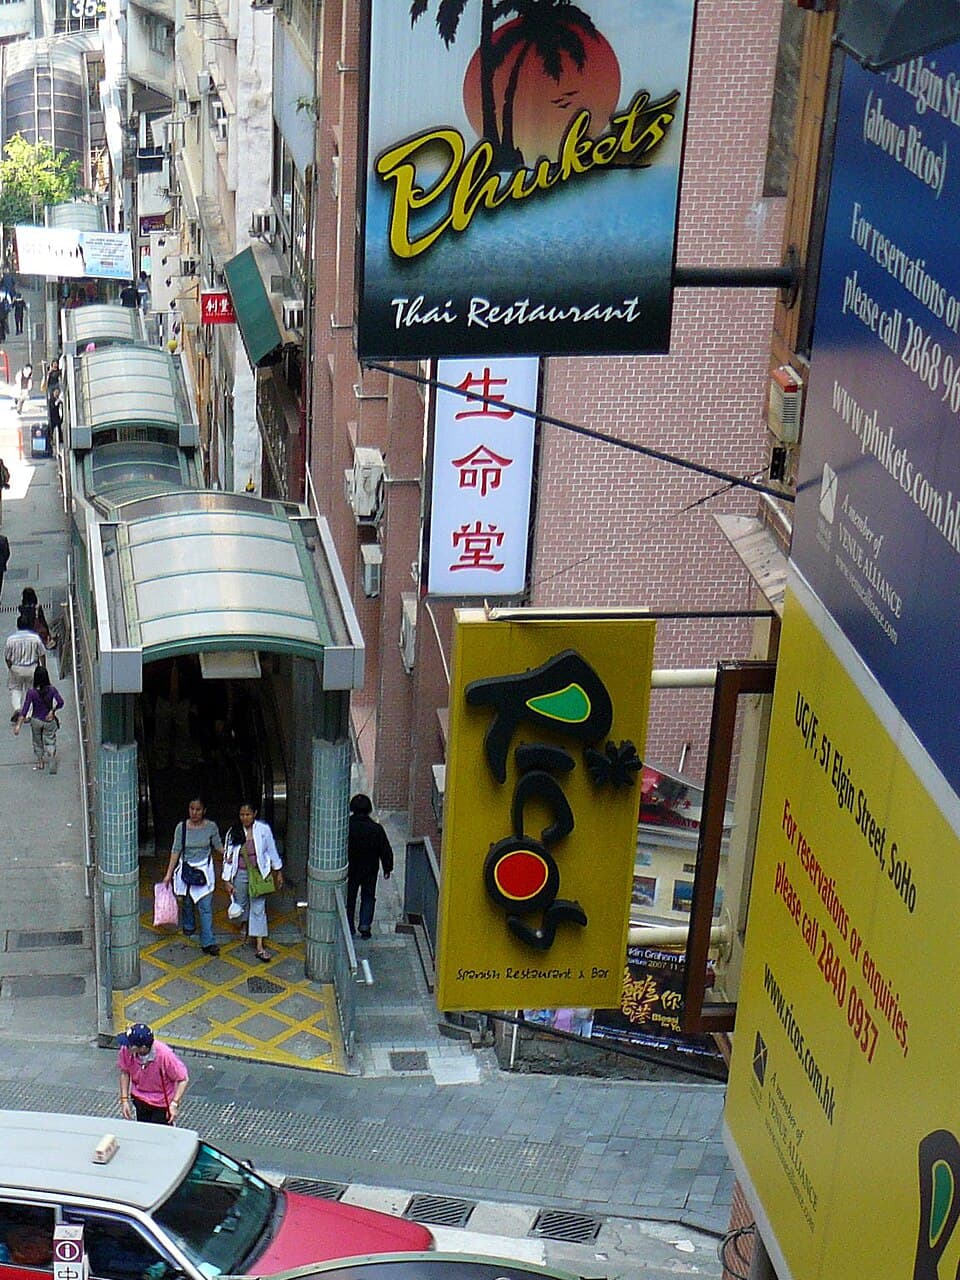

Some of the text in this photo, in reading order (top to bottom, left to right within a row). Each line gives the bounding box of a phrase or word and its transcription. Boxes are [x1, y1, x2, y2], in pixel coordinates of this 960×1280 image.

[864, 89, 904, 163] (above
[904, 124, 947, 201] Ricos)
[906, 56, 942, 114] Elgin
[377, 90, 680, 257] Phukets
[391, 296, 640, 328] Thai Restaurant
[850, 202, 873, 253] For
[872, 229, 946, 318] reservations
[843, 270, 960, 413] please call 2868 96
[450, 367, 514, 572] 生命堂
[832, 380, 960, 554] www.phukets.com.hk
[862, 555, 901, 618] ALLIANCE
[795, 691, 917, 913] UG/F, 51 Elgin Street, SoHo
[506, 966, 572, 981] Restaurant
[591, 966, 610, 980] Bar
[774, 861, 879, 1064] please call 2840 0937
[782, 798, 909, 1059] For reservations or enquiries,
[764, 963, 836, 1126] www.ricos.com.hk
